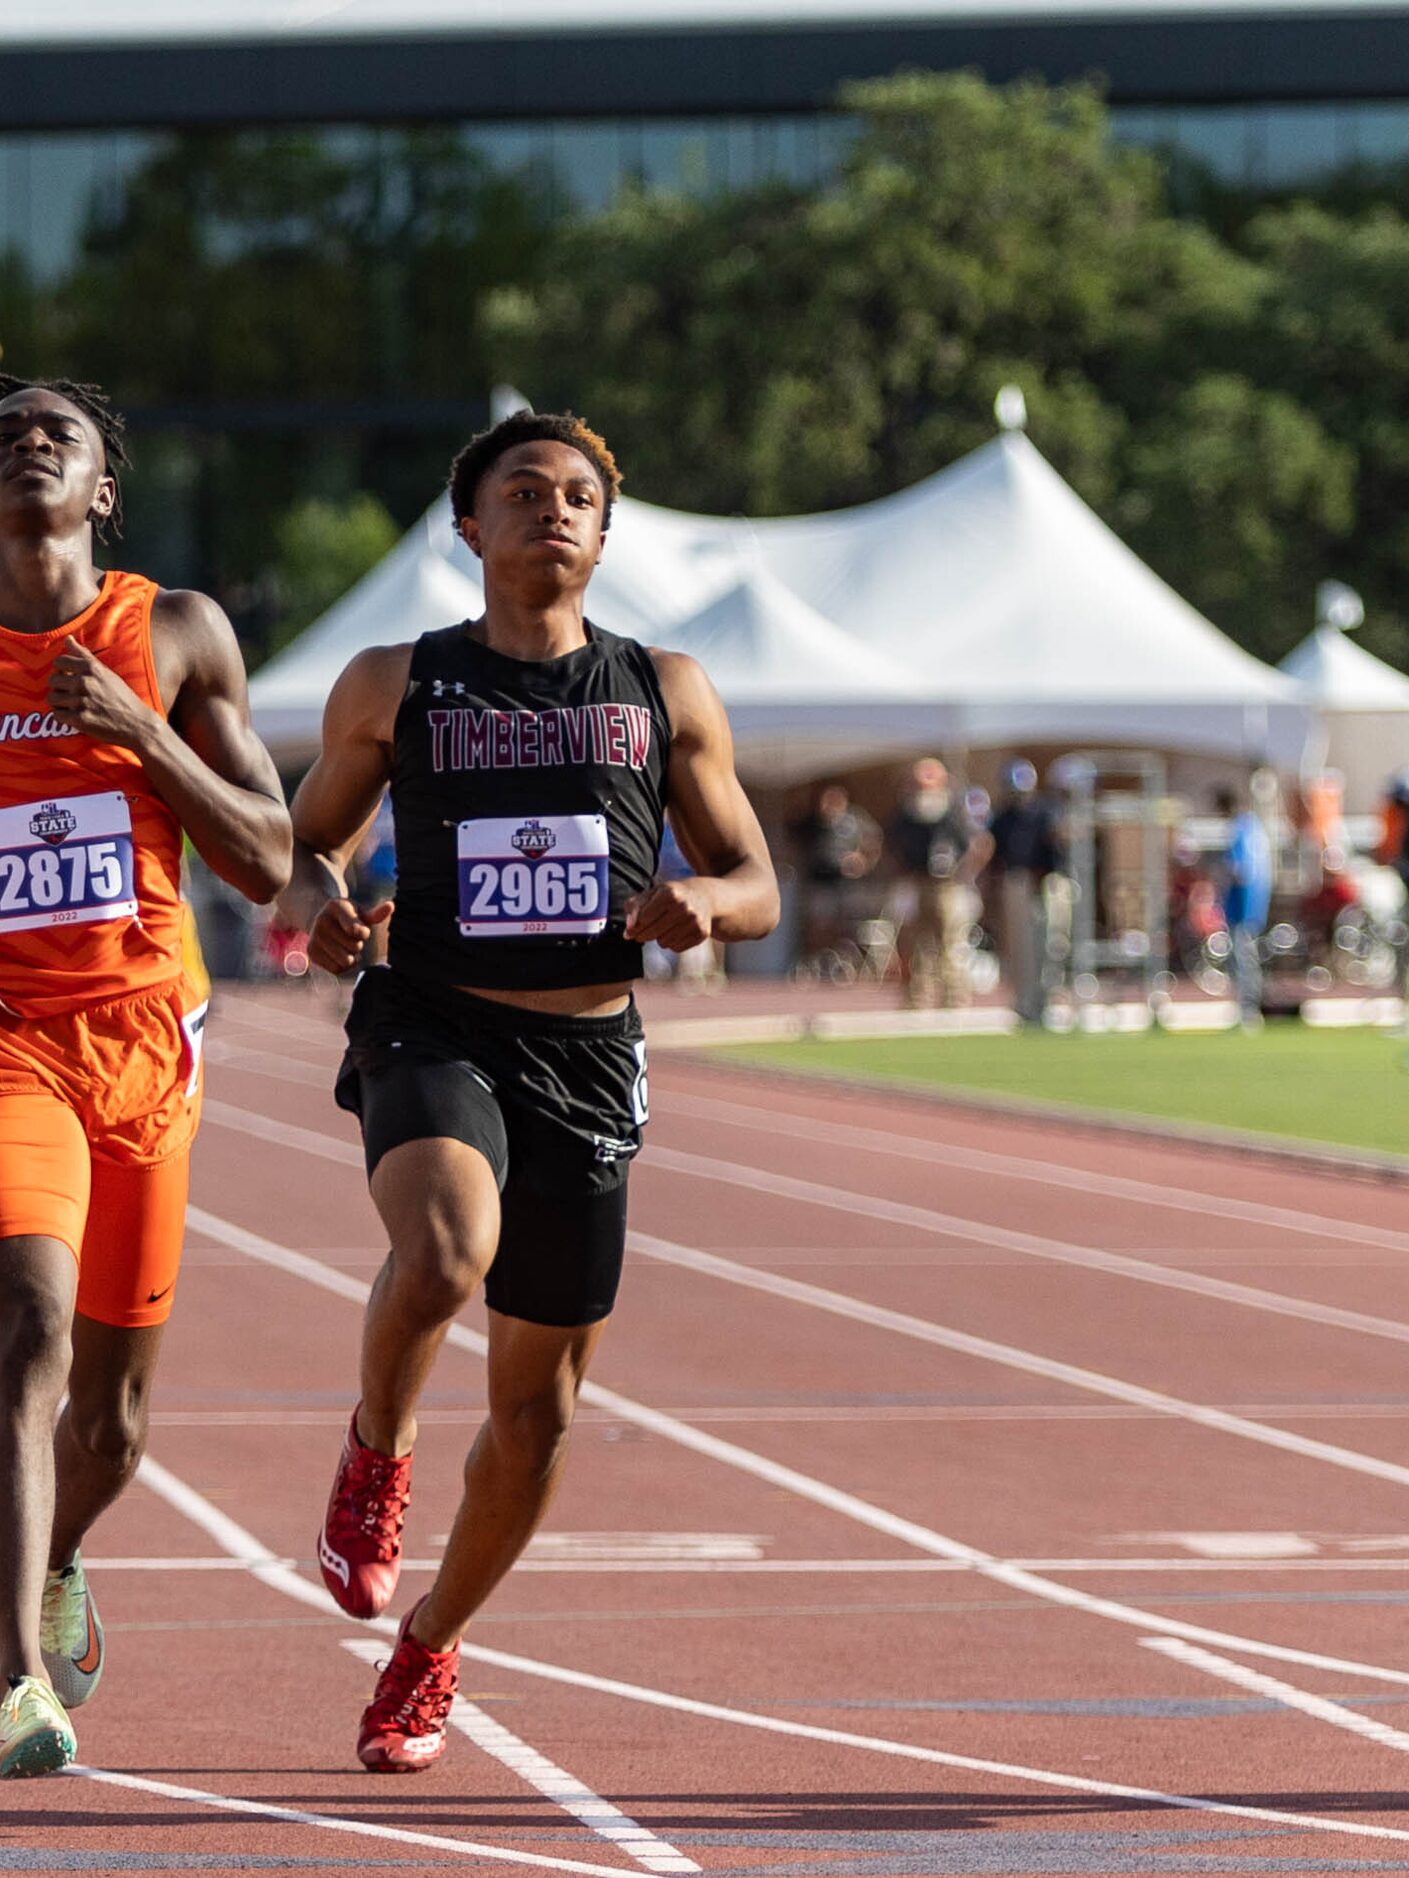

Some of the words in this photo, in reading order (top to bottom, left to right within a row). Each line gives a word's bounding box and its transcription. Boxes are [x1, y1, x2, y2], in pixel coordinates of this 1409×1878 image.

[428, 703, 651, 772] TIMBERVIEW
[30, 818, 75, 832] STATE
[512, 835, 556, 847] STATE
[469, 862, 598, 917] 2965
[51, 911, 79, 922] 2022
[523, 923, 548, 932] 2022
